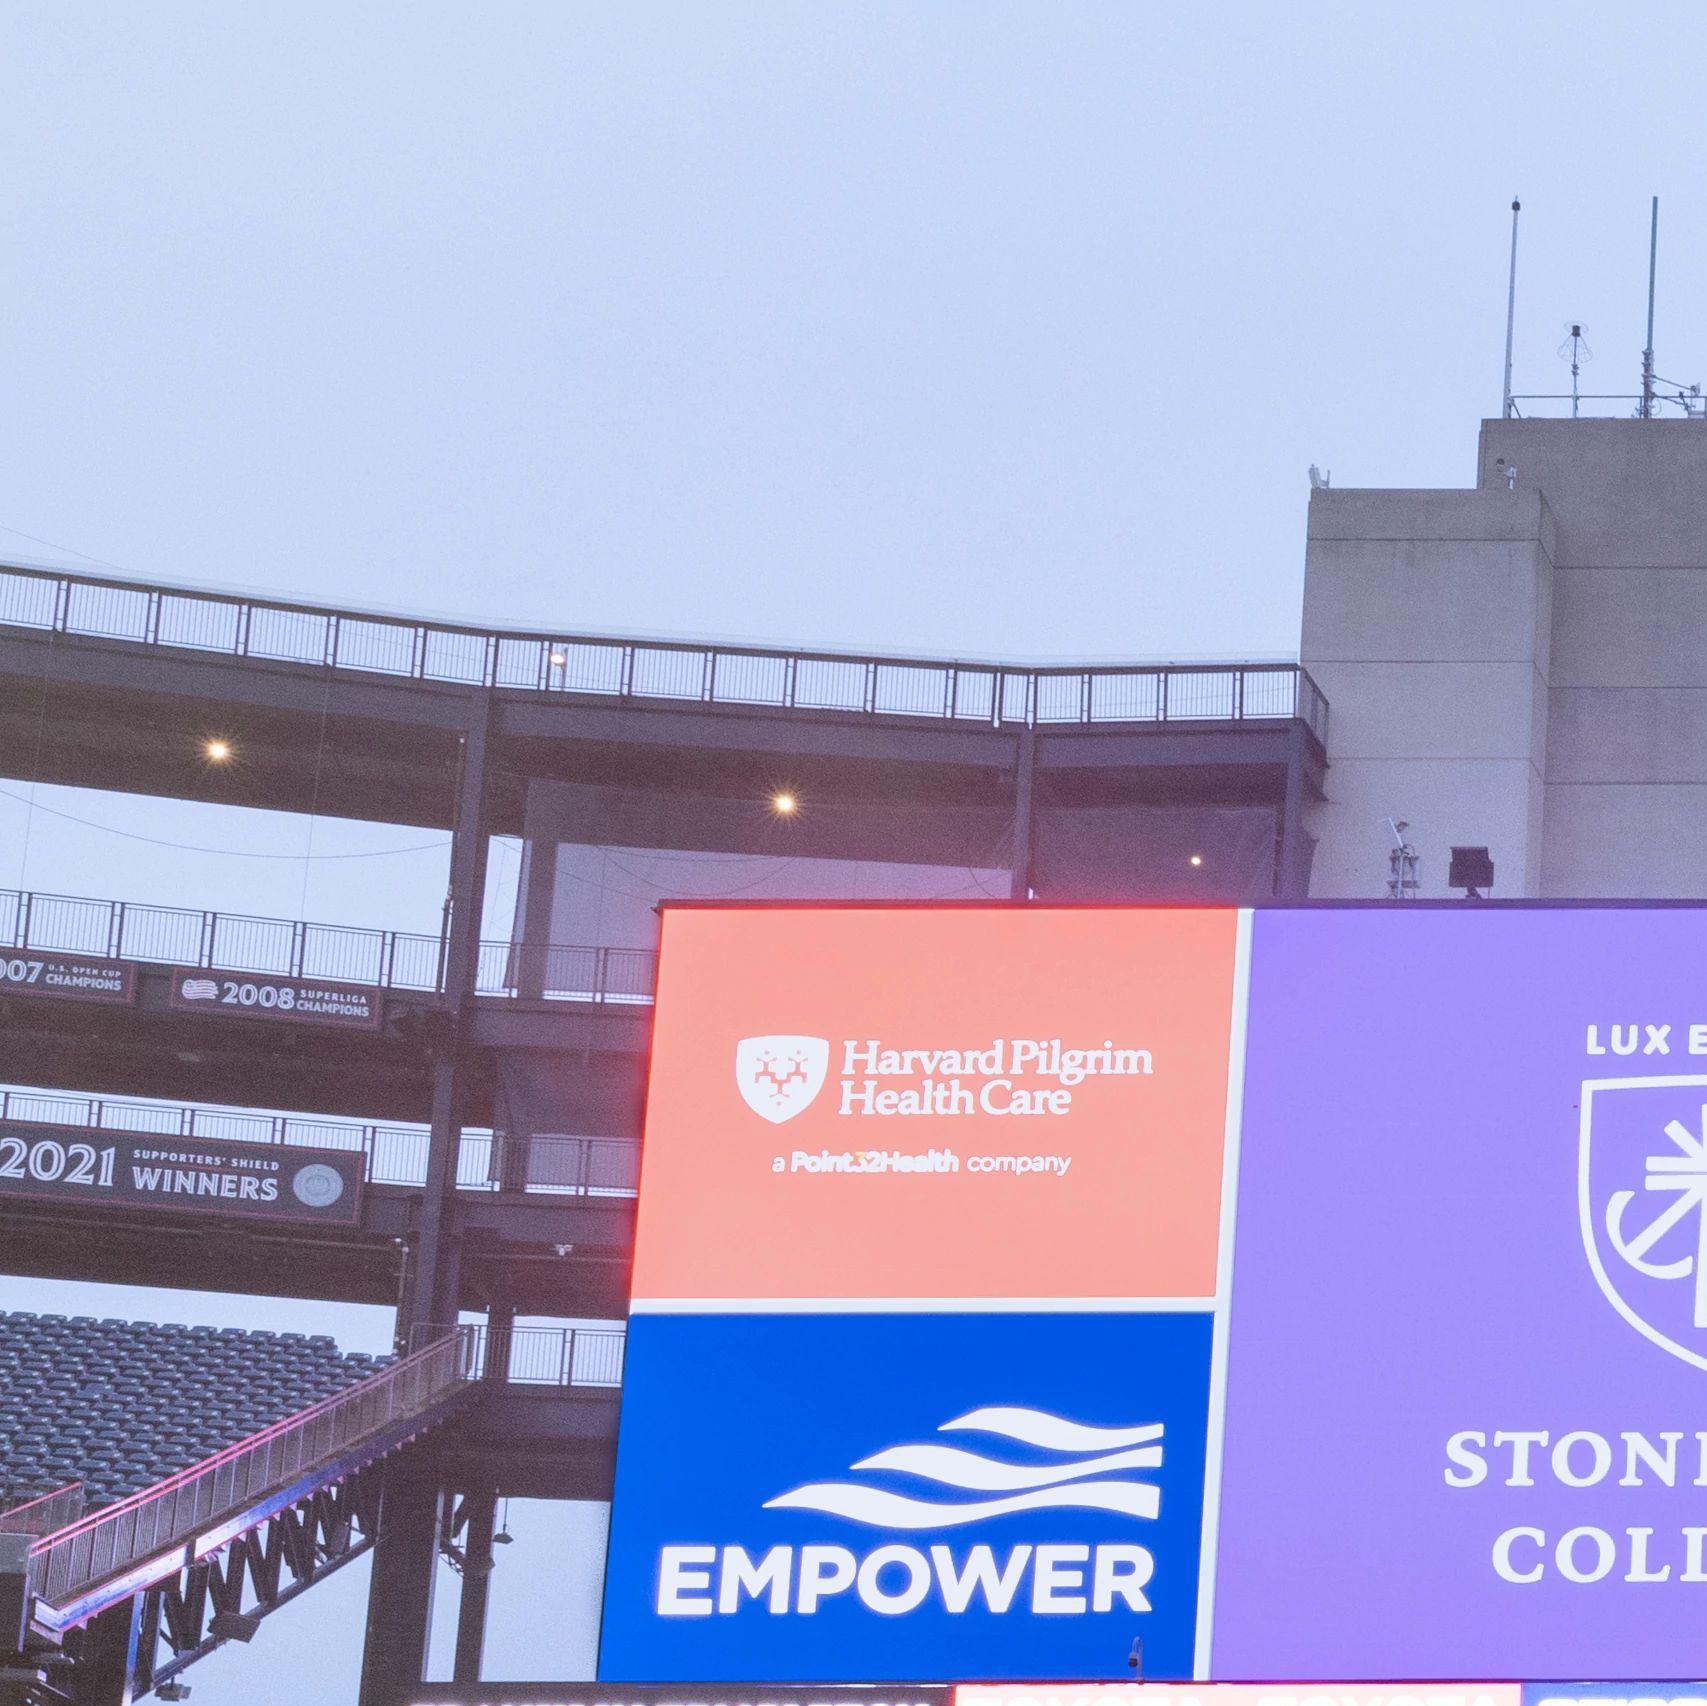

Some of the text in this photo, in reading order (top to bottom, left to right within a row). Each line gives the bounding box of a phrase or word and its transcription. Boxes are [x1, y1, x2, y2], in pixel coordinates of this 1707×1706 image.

[45, 973, 123, 992] CHAMPIONS
[72, 966, 99, 976] OPEN
[221, 981, 296, 1009] 2008
[296, 999, 370, 1018] CHAMPIONS
[300, 988, 368, 1005] SUPERLIGA
[1585, 1023, 1672, 1056] LUX
[840, 1038, 1154, 1086] Harvard Pilgrim
[838, 1079, 1073, 1116] Health Care
[0, 1136, 117, 1187] 2021
[231, 1158, 280, 1171] SHIELD
[771, 1154, 785, 1173] a
[966, 1153, 1073, 1177] company
[132, 1166, 279, 1201] WINNERS
[656, 1543, 1156, 1616] EMPOWER
